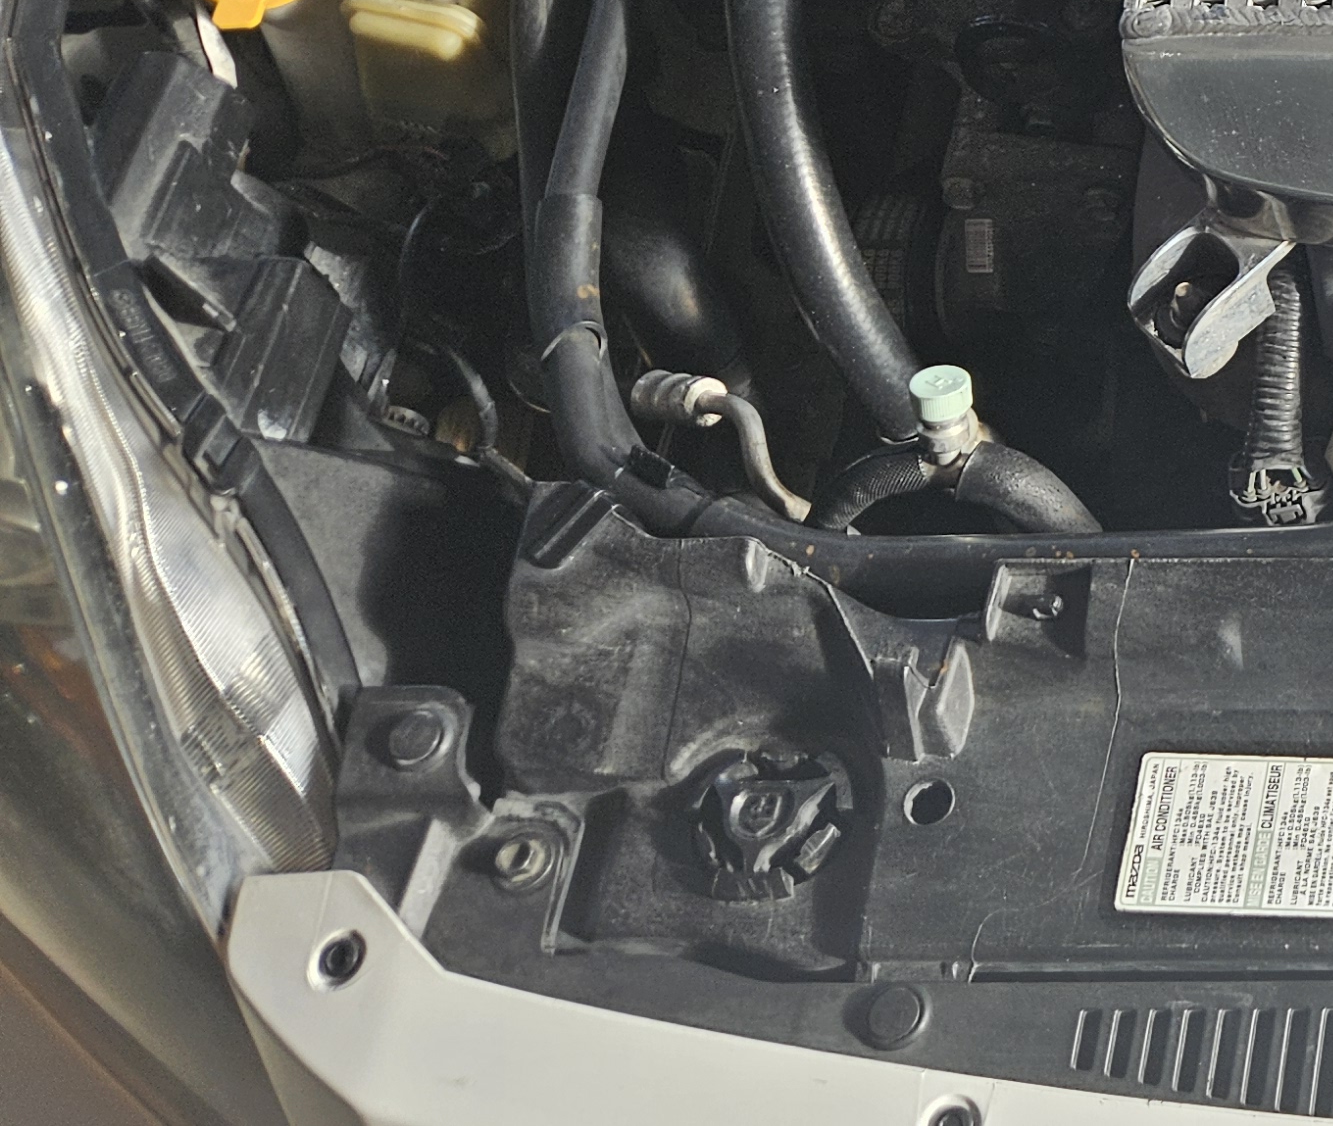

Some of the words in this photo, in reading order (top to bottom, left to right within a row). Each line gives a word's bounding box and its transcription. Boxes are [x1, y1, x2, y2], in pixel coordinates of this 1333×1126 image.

[1146, 763, 1159, 789] JAPAN
[1223, 766, 1231, 781] high
[1231, 769, 1239, 777] by
[1154, 766, 1177, 831] CONDITIONER
[1218, 784, 1228, 805] under
[1225, 780, 1237, 811] serviced
[1260, 764, 1282, 828] CLIMATISEUR
[1205, 813, 1213, 828] SAE
[1215, 808, 1223, 823] fluid
[1223, 814, 1231, 822] be
[1239, 799, 1249, 820] cause
[1150, 834, 1164, 850] AIR
[1201, 830, 1210, 849] WITH
[1236, 823, 1244, 837] may
[1308, 828, 1316, 843] SAE
[1216, 836, 1227, 863] System
[1230, 840, 1241, 871] methods
[1253, 832, 1270, 864] GARDE
[1303, 847, 1313, 873] NORME
[1184, 857, 1197, 901] LUBRICANT
[1193, 853, 1206, 893] COMPLIES
[1217, 870, 1228, 902] qualified
[1223, 830, 1235, 867] personnel
[1232, 873, 1243, 903] Consult
[1238, 853, 1247, 870] shop
[1251, 868, 1264, 880] EN
[1140, 861, 1159, 902] CAUTION
[1224, 875, 1235, 902] service
[1290, 860, 1303, 904] LUBRICANT
[1301, 877, 1308, 886] LA
